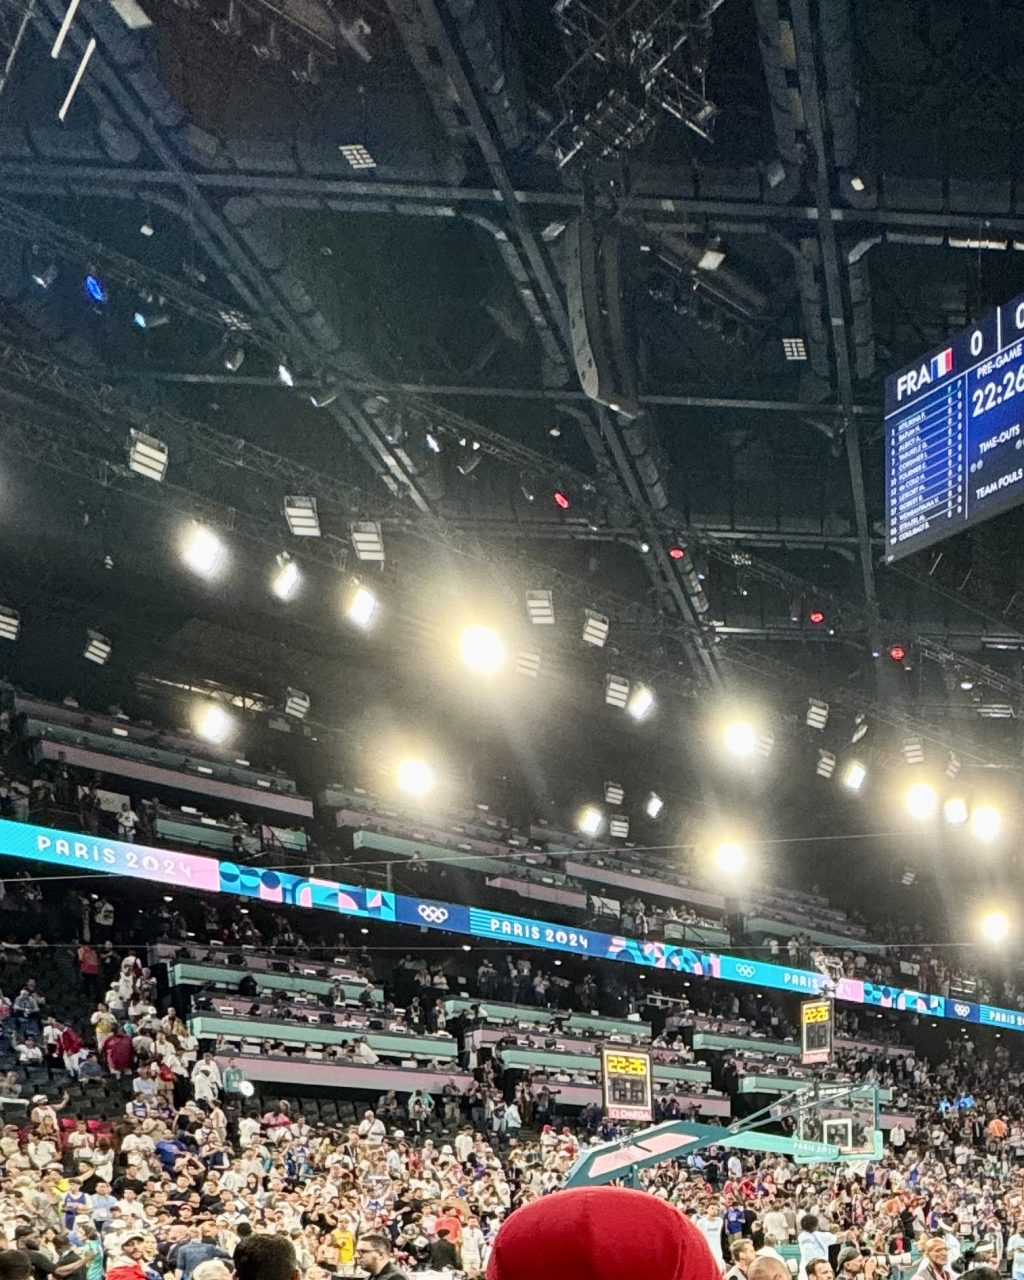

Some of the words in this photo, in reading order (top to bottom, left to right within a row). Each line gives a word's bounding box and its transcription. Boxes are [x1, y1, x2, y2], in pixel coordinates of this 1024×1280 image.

[897, 364, 931, 401] FRA
[971, 330, 983, 356] 0
[977, 344, 1022, 380] PRE-GAME
[979, 424, 1020, 454] TIME-OUTS
[976, 481, 998, 499] TEAM
[998, 468, 1023, 489] FOULS
[125, 852, 192, 878] 2024
[545, 929, 588, 949] 2024
[607, 1056, 647, 1076] 22:26
[620, 1109, 649, 1119] OMEGA
